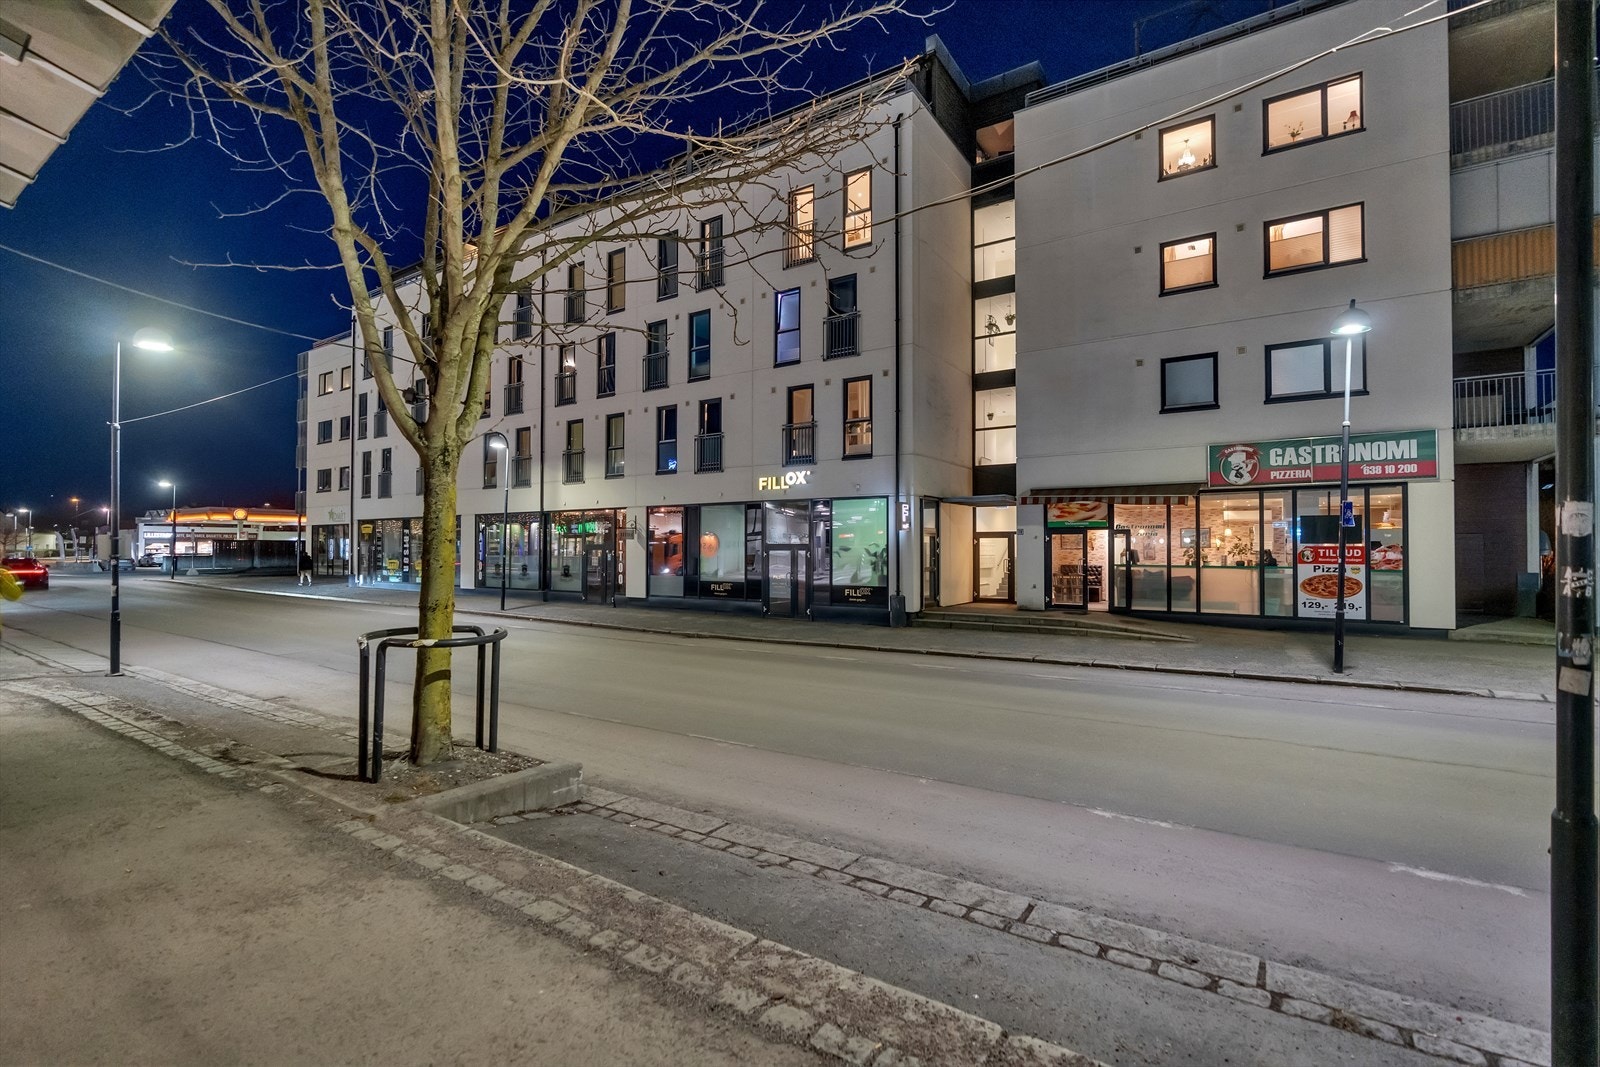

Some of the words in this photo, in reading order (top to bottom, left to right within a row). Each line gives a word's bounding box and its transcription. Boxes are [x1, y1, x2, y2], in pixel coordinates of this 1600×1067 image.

[1363, 465, 1382, 475] 638
[1385, 464, 1395, 474] 10
[1398, 463, 1418, 474] 200
[1270, 469, 1312, 480] PIZZERIA
[1318, 549, 1362, 557] TILUD
[1313, 565, 1347, 573] Pizz
[1301, 601, 1329, 610] 129,-
